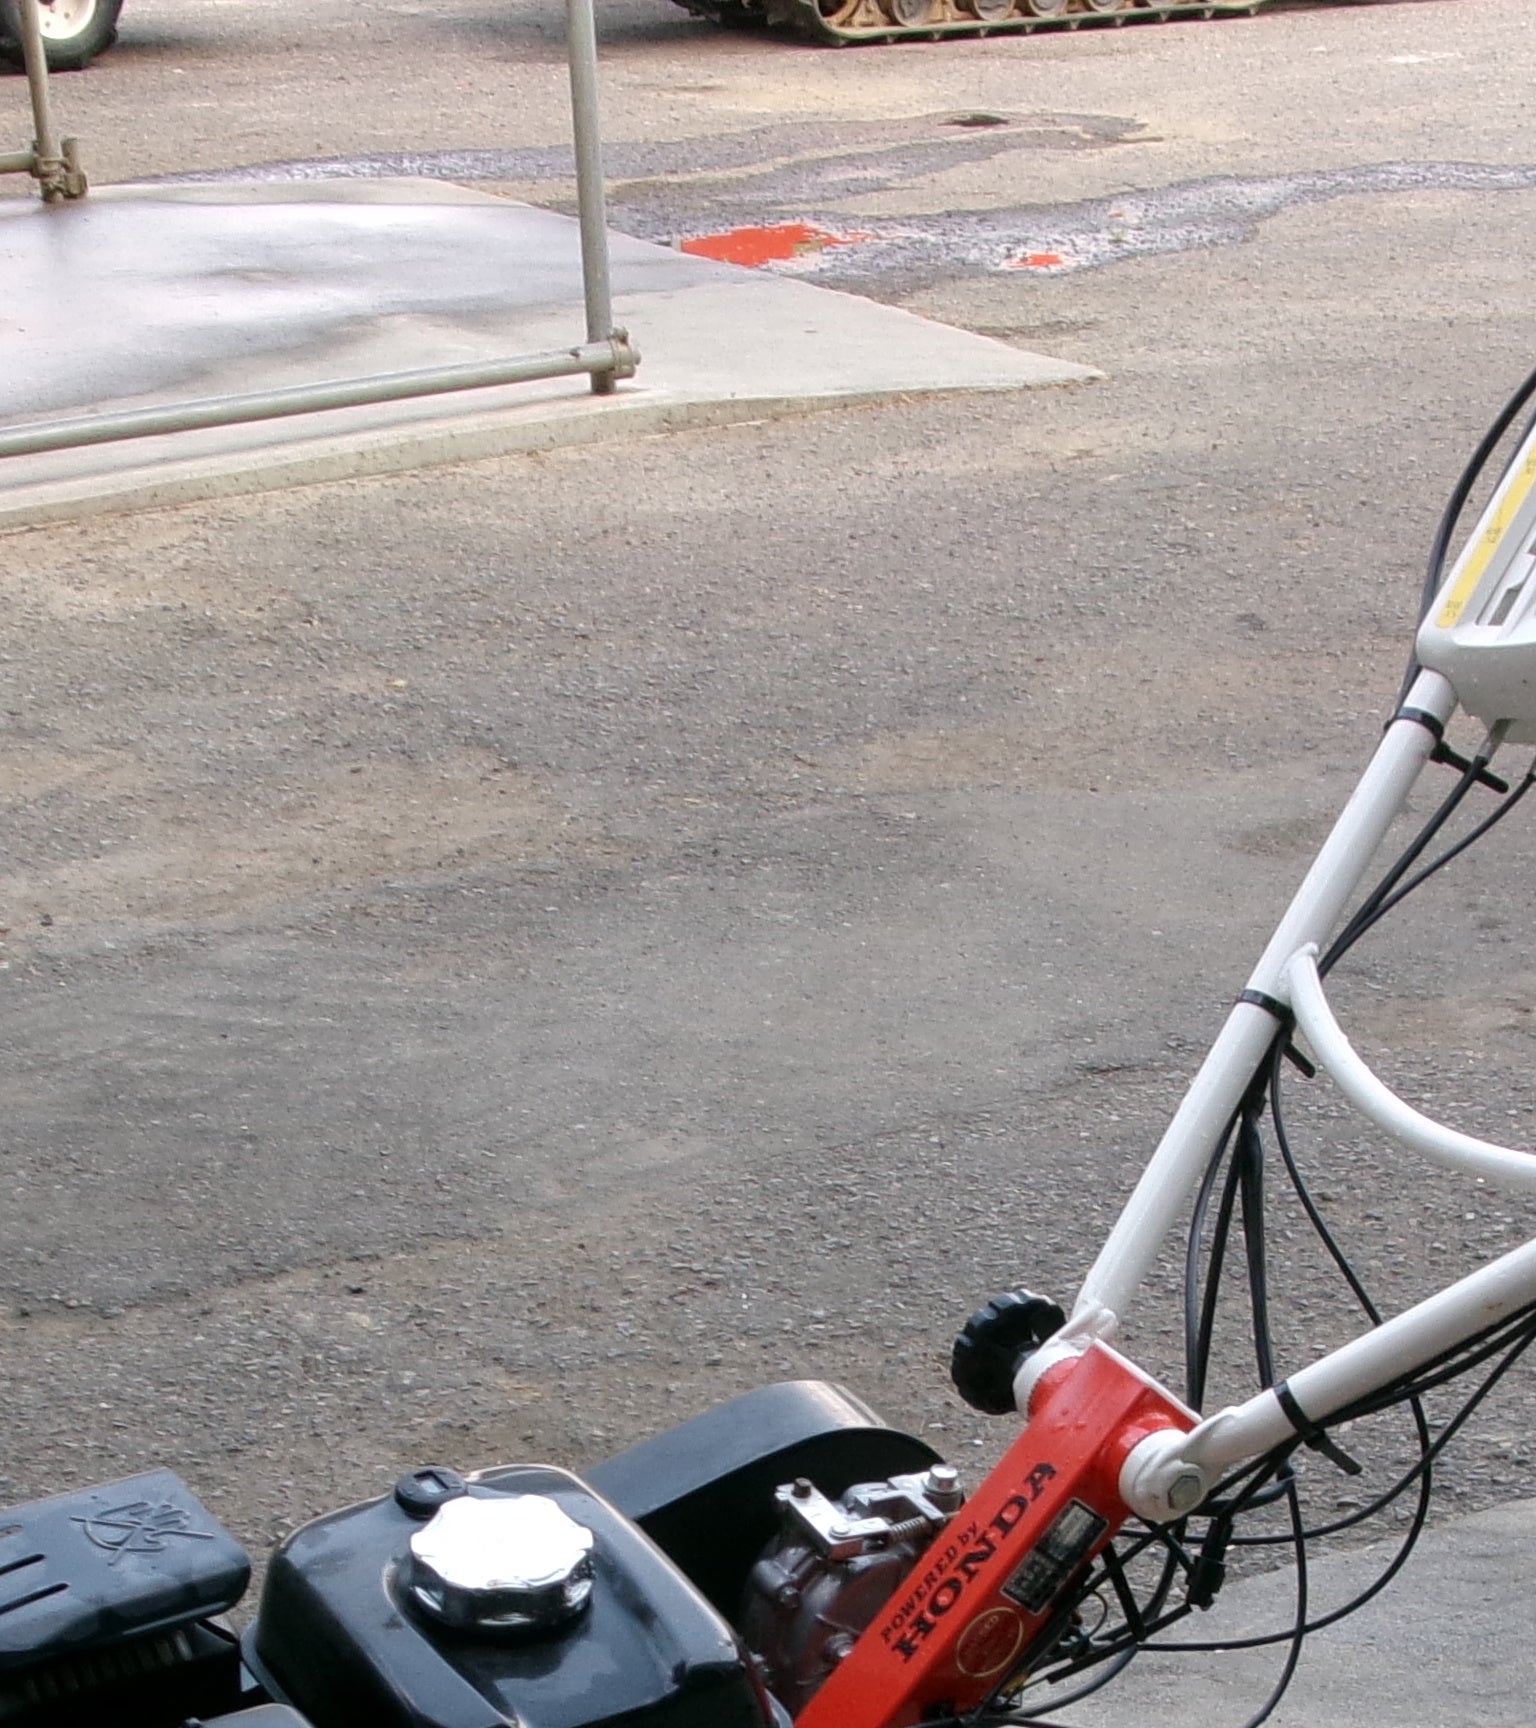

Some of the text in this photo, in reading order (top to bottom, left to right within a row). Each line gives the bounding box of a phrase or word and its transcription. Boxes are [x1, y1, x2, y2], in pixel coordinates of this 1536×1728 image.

[880, 1521, 978, 1644] POWERED by
[891, 1462, 1057, 1664] HONDA
